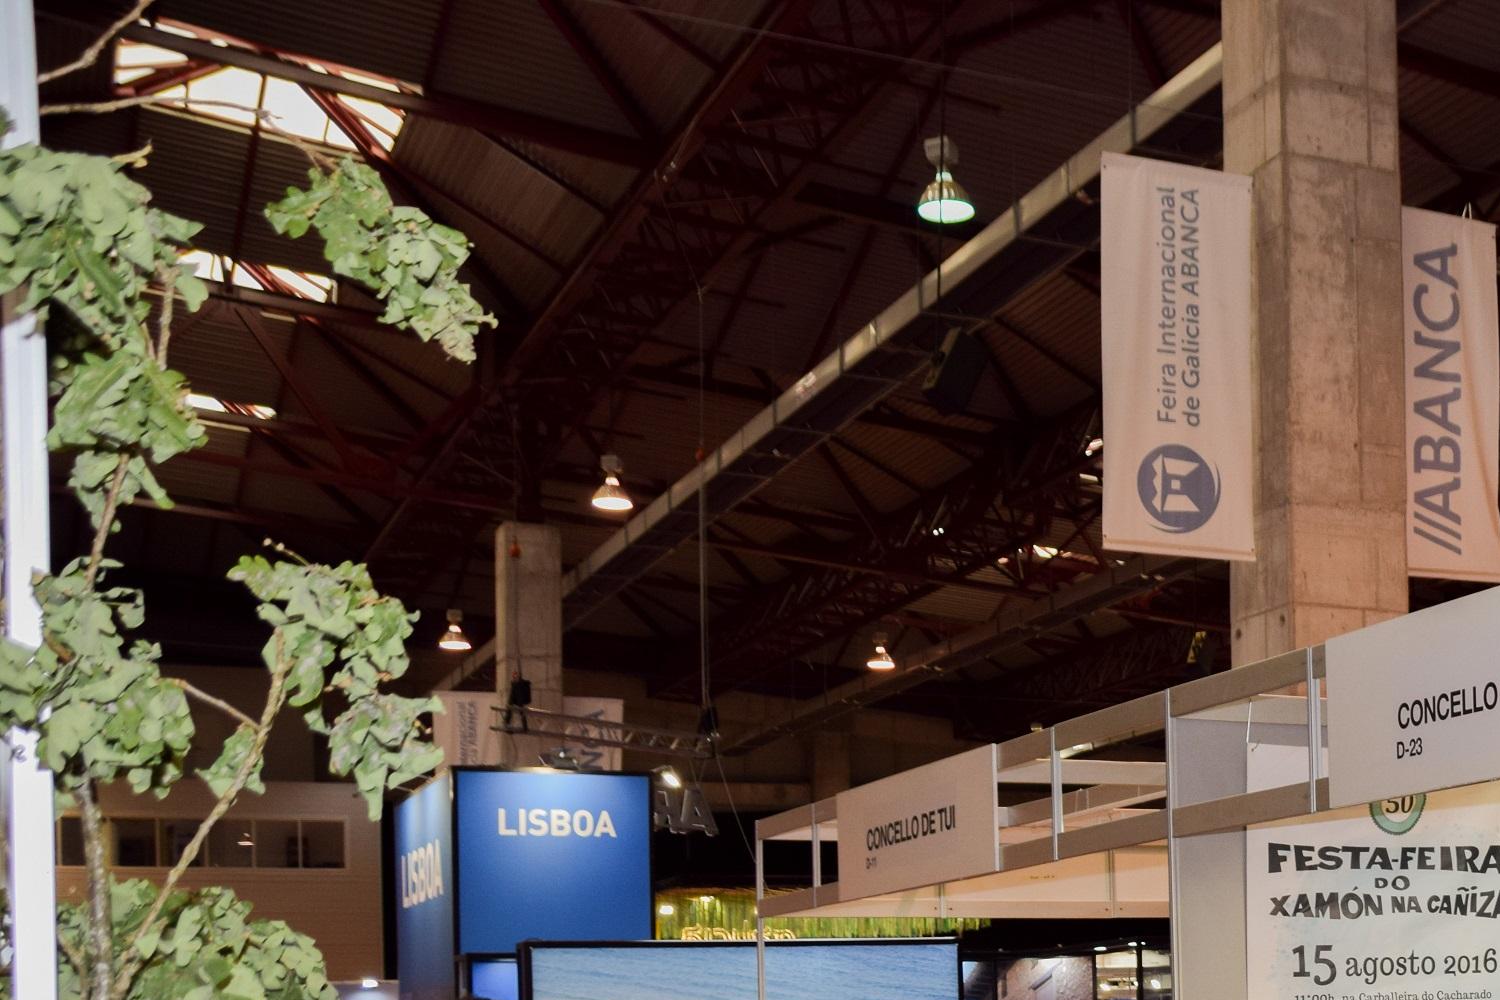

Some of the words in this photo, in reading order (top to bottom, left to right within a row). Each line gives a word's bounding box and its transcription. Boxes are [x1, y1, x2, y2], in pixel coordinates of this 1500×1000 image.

[1182, 188, 1200, 296] ABANCA
[1157, 187, 1176, 354] Internacional
[1181, 303, 1200, 389] Galicia
[1157, 364, 1176, 424] Feira
[1182, 401, 1201, 427] de
[1397, 680, 1499, 729] CONCELLO
[1396, 738, 1423, 759] D-23
[497, 808, 617, 838] LISBOA
[866, 815, 919, 851] CONCELLO
[921, 811, 936, 836] DE
[938, 805, 956, 831] TUI
[401, 838, 444, 908] LISBOA
[1374, 875, 1411, 891] DO
[1269, 886, 1384, 920] XAMÓN
[1391, 895, 1422, 914] NA
[1292, 944, 1337, 986] 15
[1345, 950, 1435, 984] agosto
[1444, 948, 1497, 976] 2016
[1422, 991, 1434, 1000] do
[1437, 989, 1492, 1000] Cacharado
